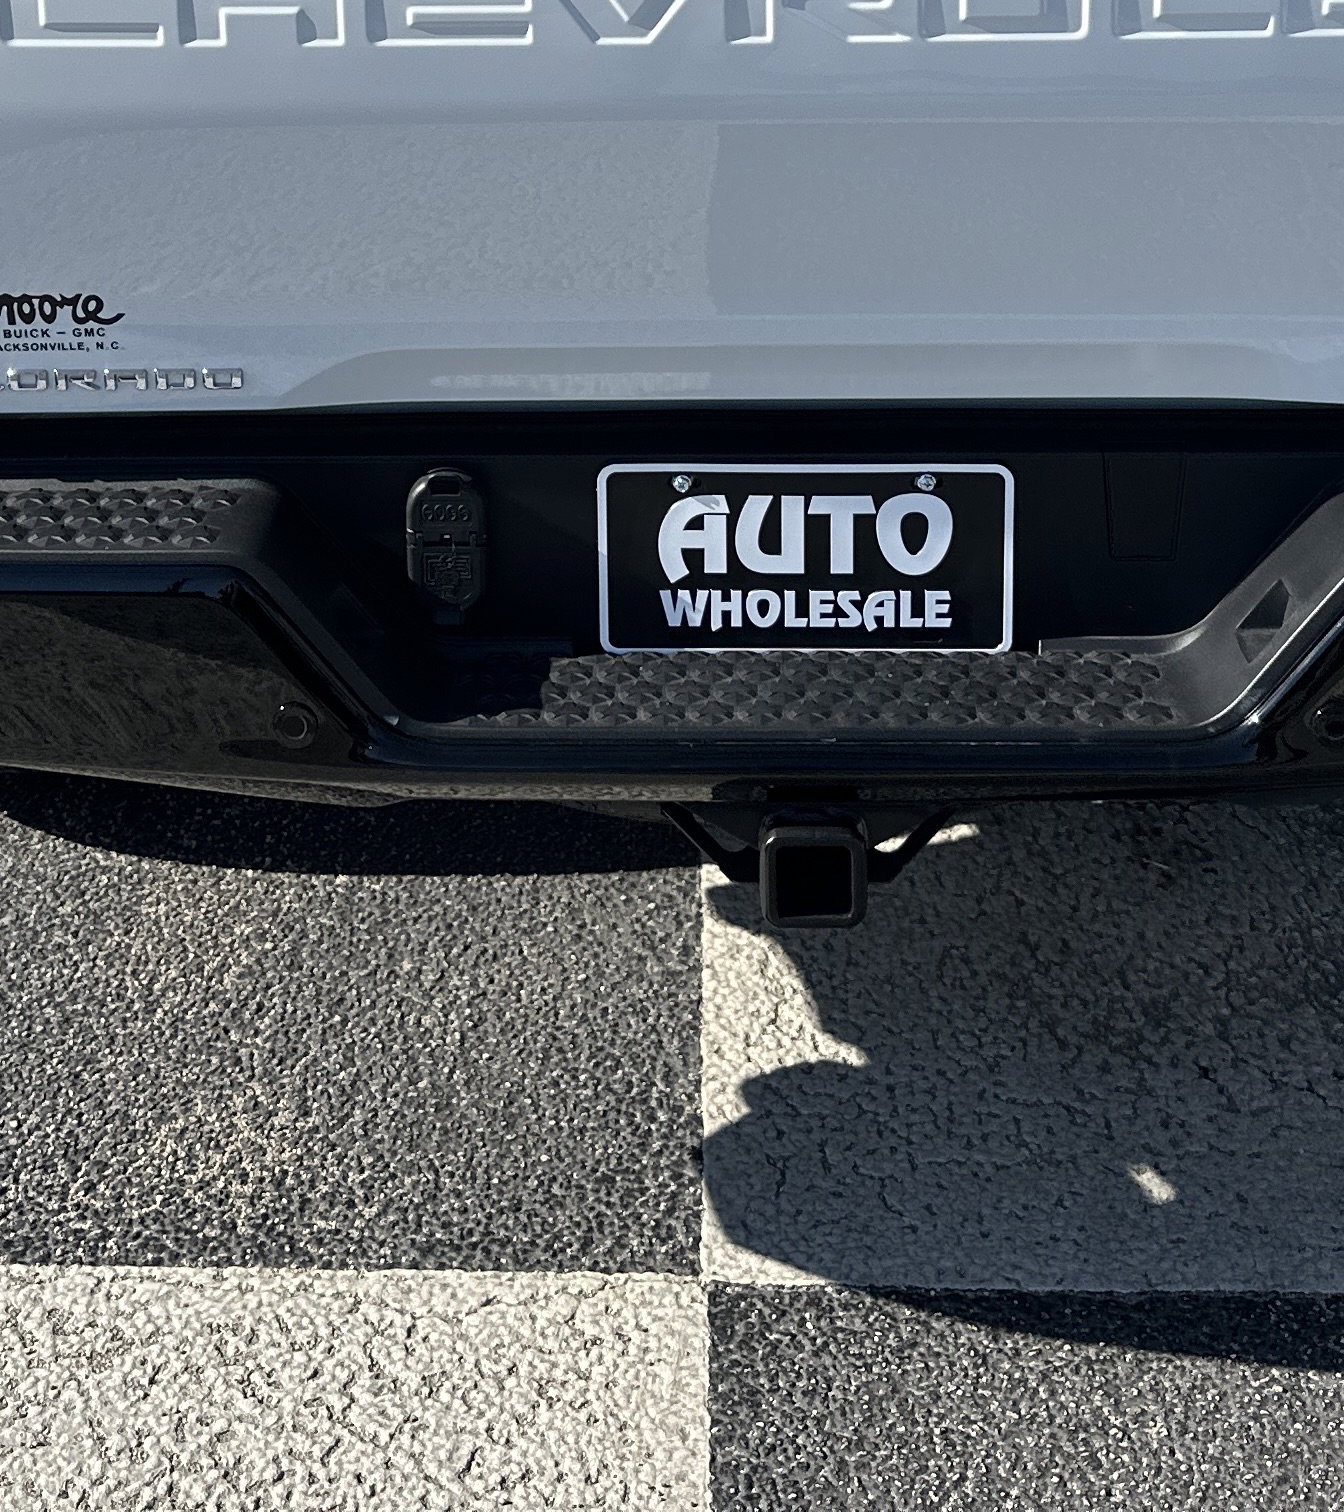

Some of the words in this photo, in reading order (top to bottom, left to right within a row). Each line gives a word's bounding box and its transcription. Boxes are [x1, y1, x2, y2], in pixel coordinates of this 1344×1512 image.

[2, 328, 52, 339] BUICK
[71, 327, 107, 338] GMC
[657, 492, 954, 584] AUTO
[658, 588, 954, 632] WHOLESALE
